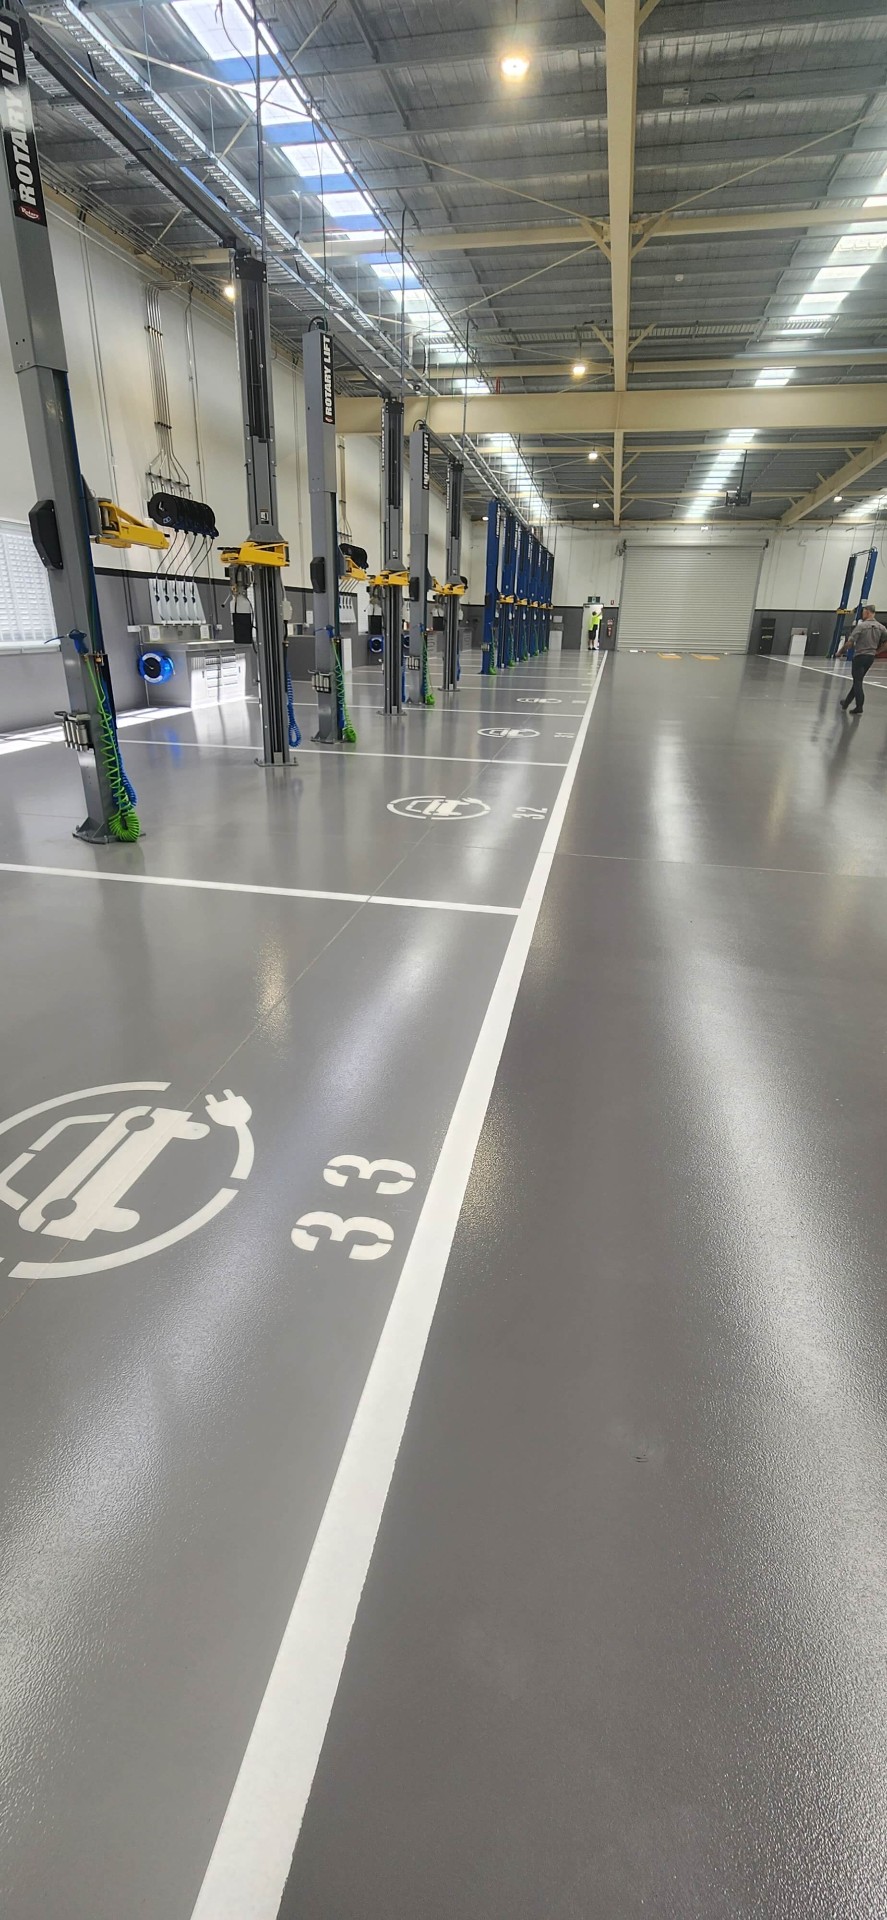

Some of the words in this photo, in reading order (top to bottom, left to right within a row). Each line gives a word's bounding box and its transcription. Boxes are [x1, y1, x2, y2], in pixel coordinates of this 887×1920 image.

[4, 86, 37, 206] ROTARY
[323, 334, 331, 364] LIFT
[324, 364, 333, 416] ROTARY
[511, 806, 548, 820] 32
[290, 1154, 416, 1261] 33
